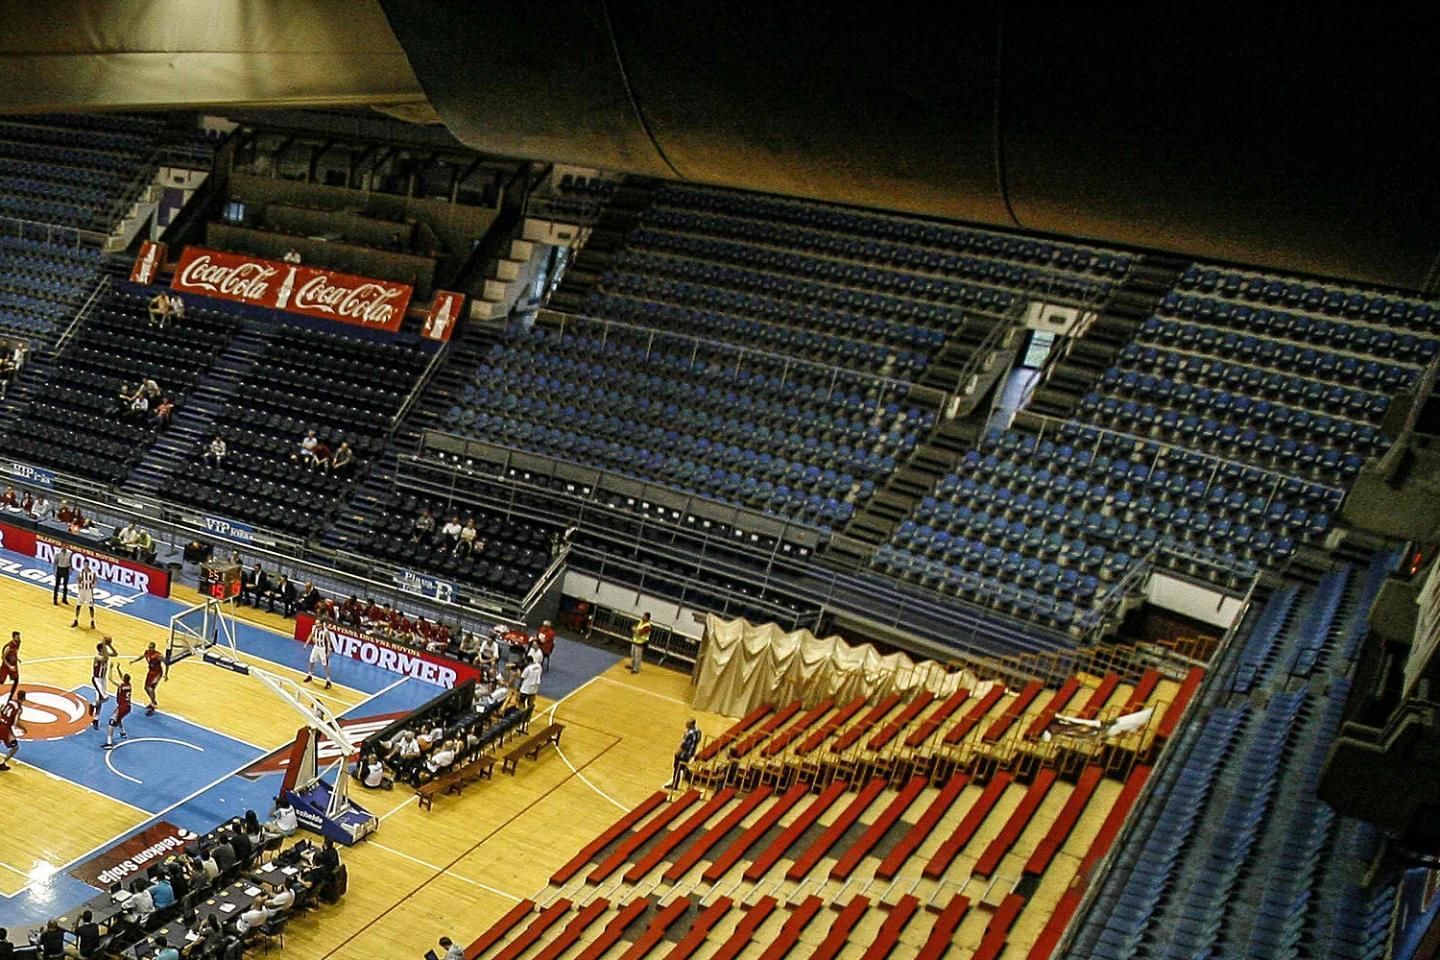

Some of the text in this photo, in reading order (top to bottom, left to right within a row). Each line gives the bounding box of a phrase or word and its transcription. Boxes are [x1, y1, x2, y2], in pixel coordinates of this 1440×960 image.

[180, 255, 279, 300] Coca-Cola
[296, 275, 402, 324] Coca-Cola
[205, 517, 230, 534] VIP
[35, 541, 149, 594] INORMER
[328, 631, 457, 690] NFORMER
[97, 835, 185, 884] Telekom Srbija
